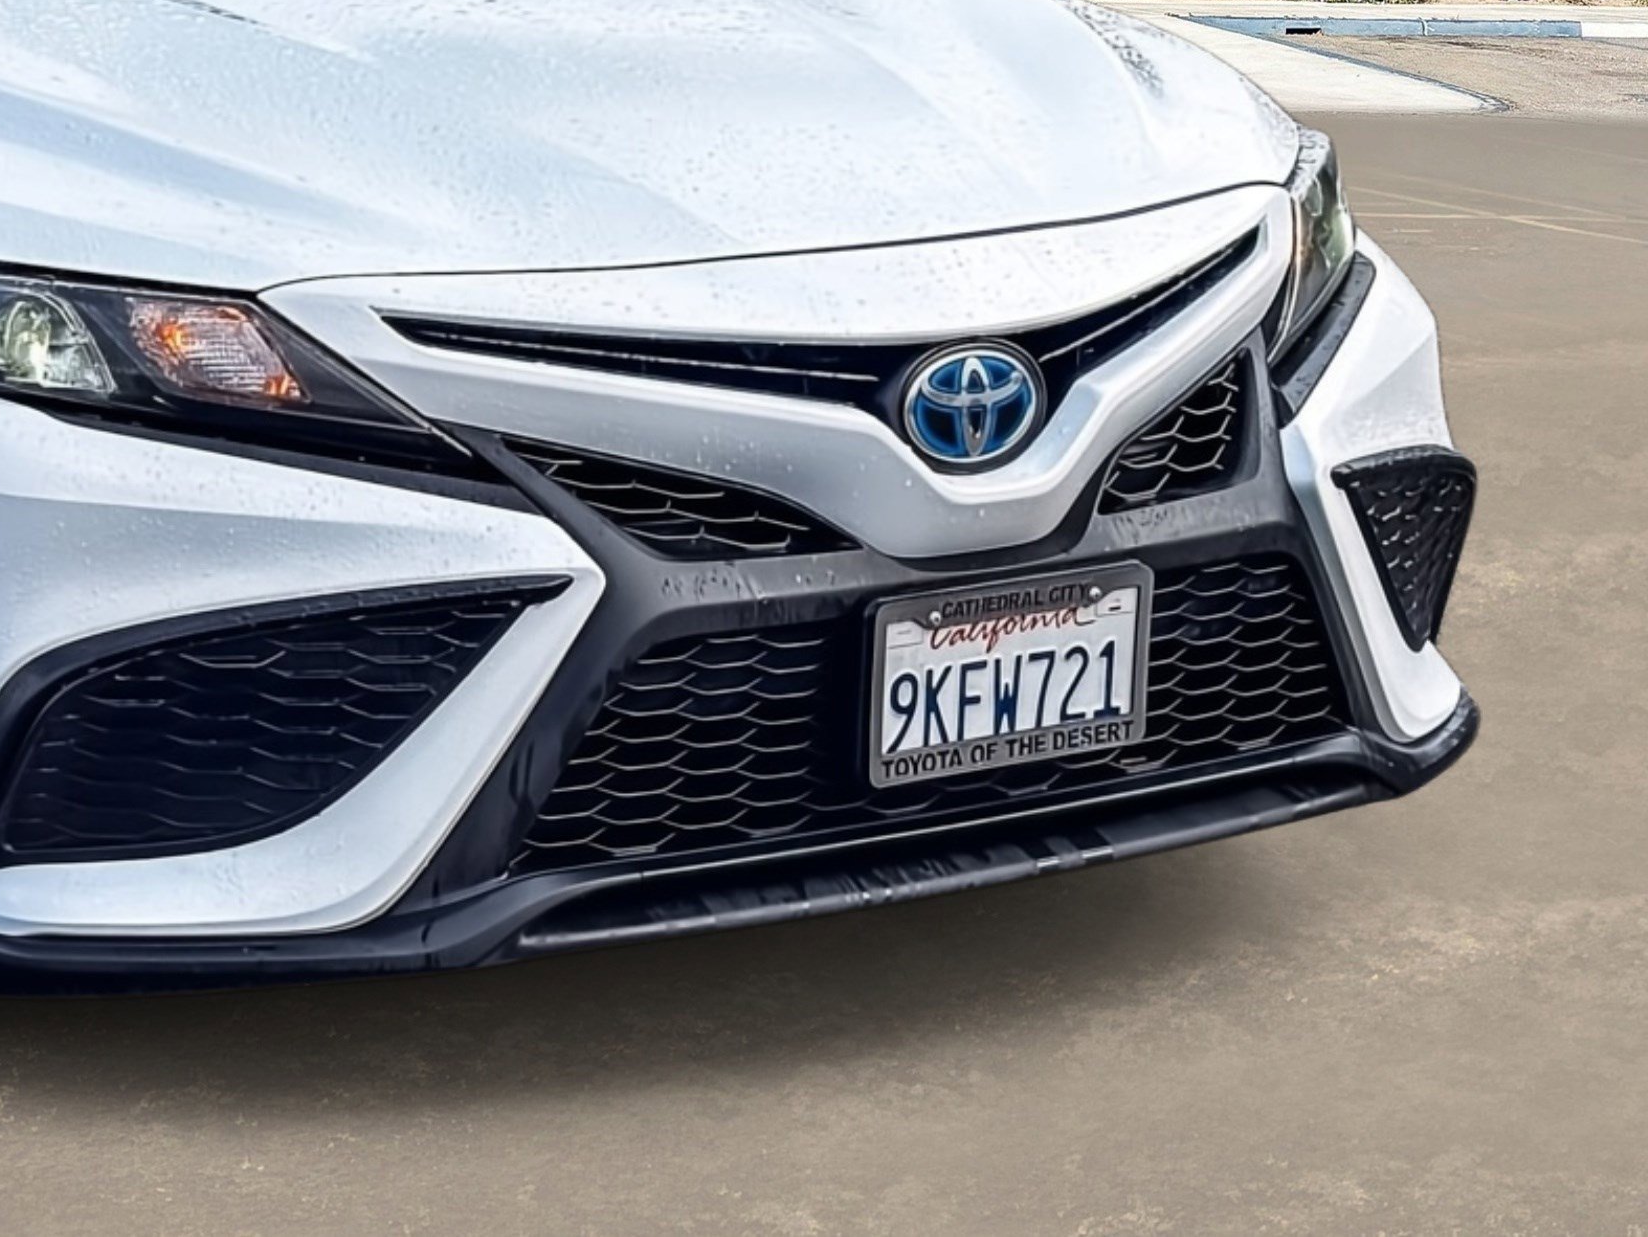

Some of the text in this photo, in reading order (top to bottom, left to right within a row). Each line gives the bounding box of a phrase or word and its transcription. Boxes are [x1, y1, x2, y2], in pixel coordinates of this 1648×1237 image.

[941, 583, 1088, 619] CATHEDRAL CITY
[929, 606, 1095, 653] California
[885, 639, 1121, 755] 9KFW721
[882, 720, 1135, 779] TOYOTA OF THE DESERT
